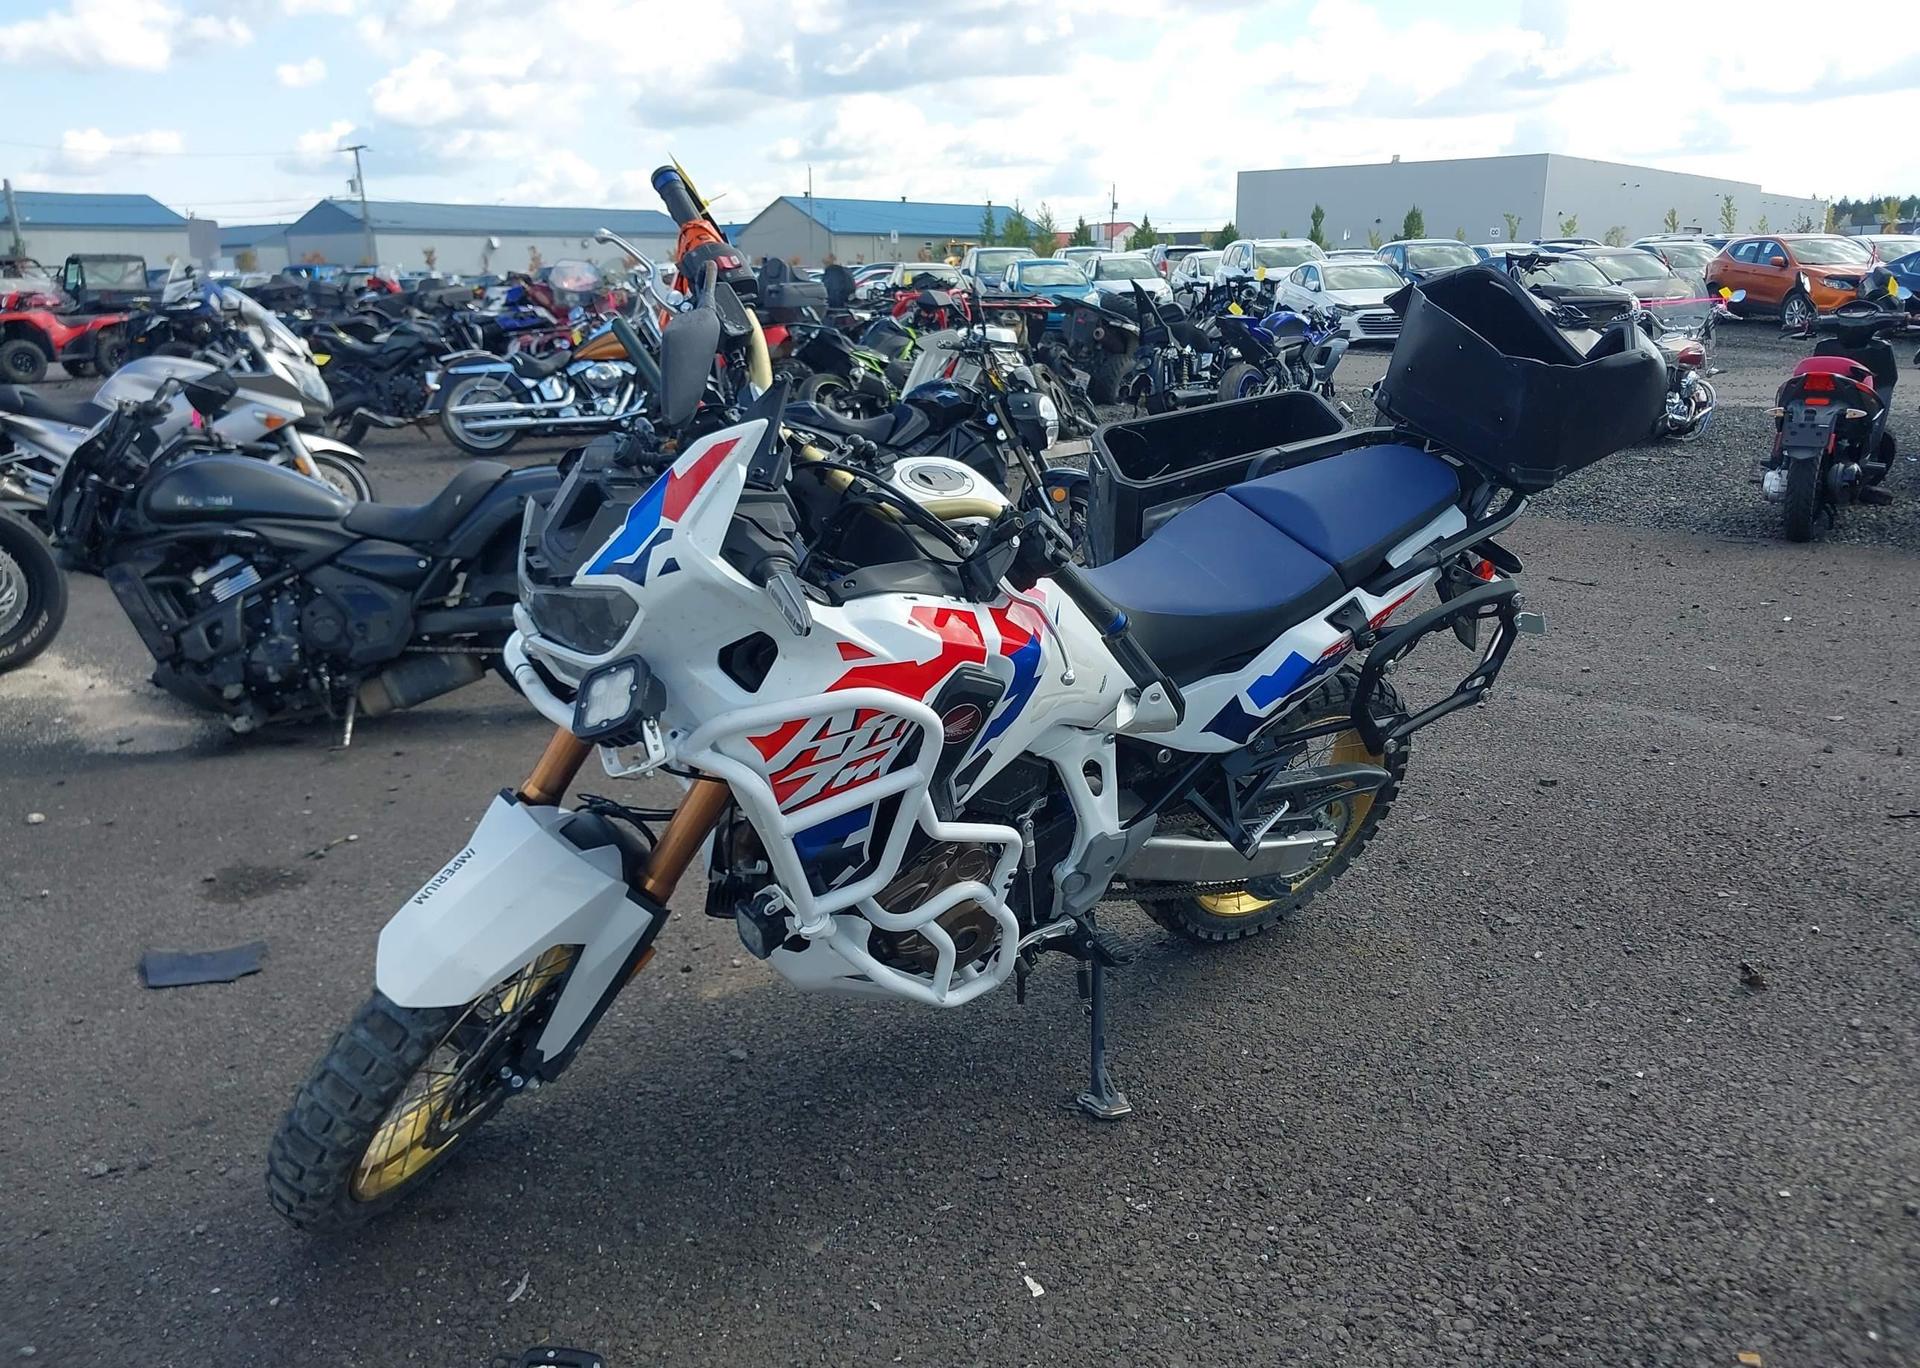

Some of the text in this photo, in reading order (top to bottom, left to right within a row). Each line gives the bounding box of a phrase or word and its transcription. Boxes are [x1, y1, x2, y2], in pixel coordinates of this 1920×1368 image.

[177, 495, 233, 507] Kaaki
[22, 610, 49, 647] AVON
[414, 847, 476, 905] IMPERIUM
